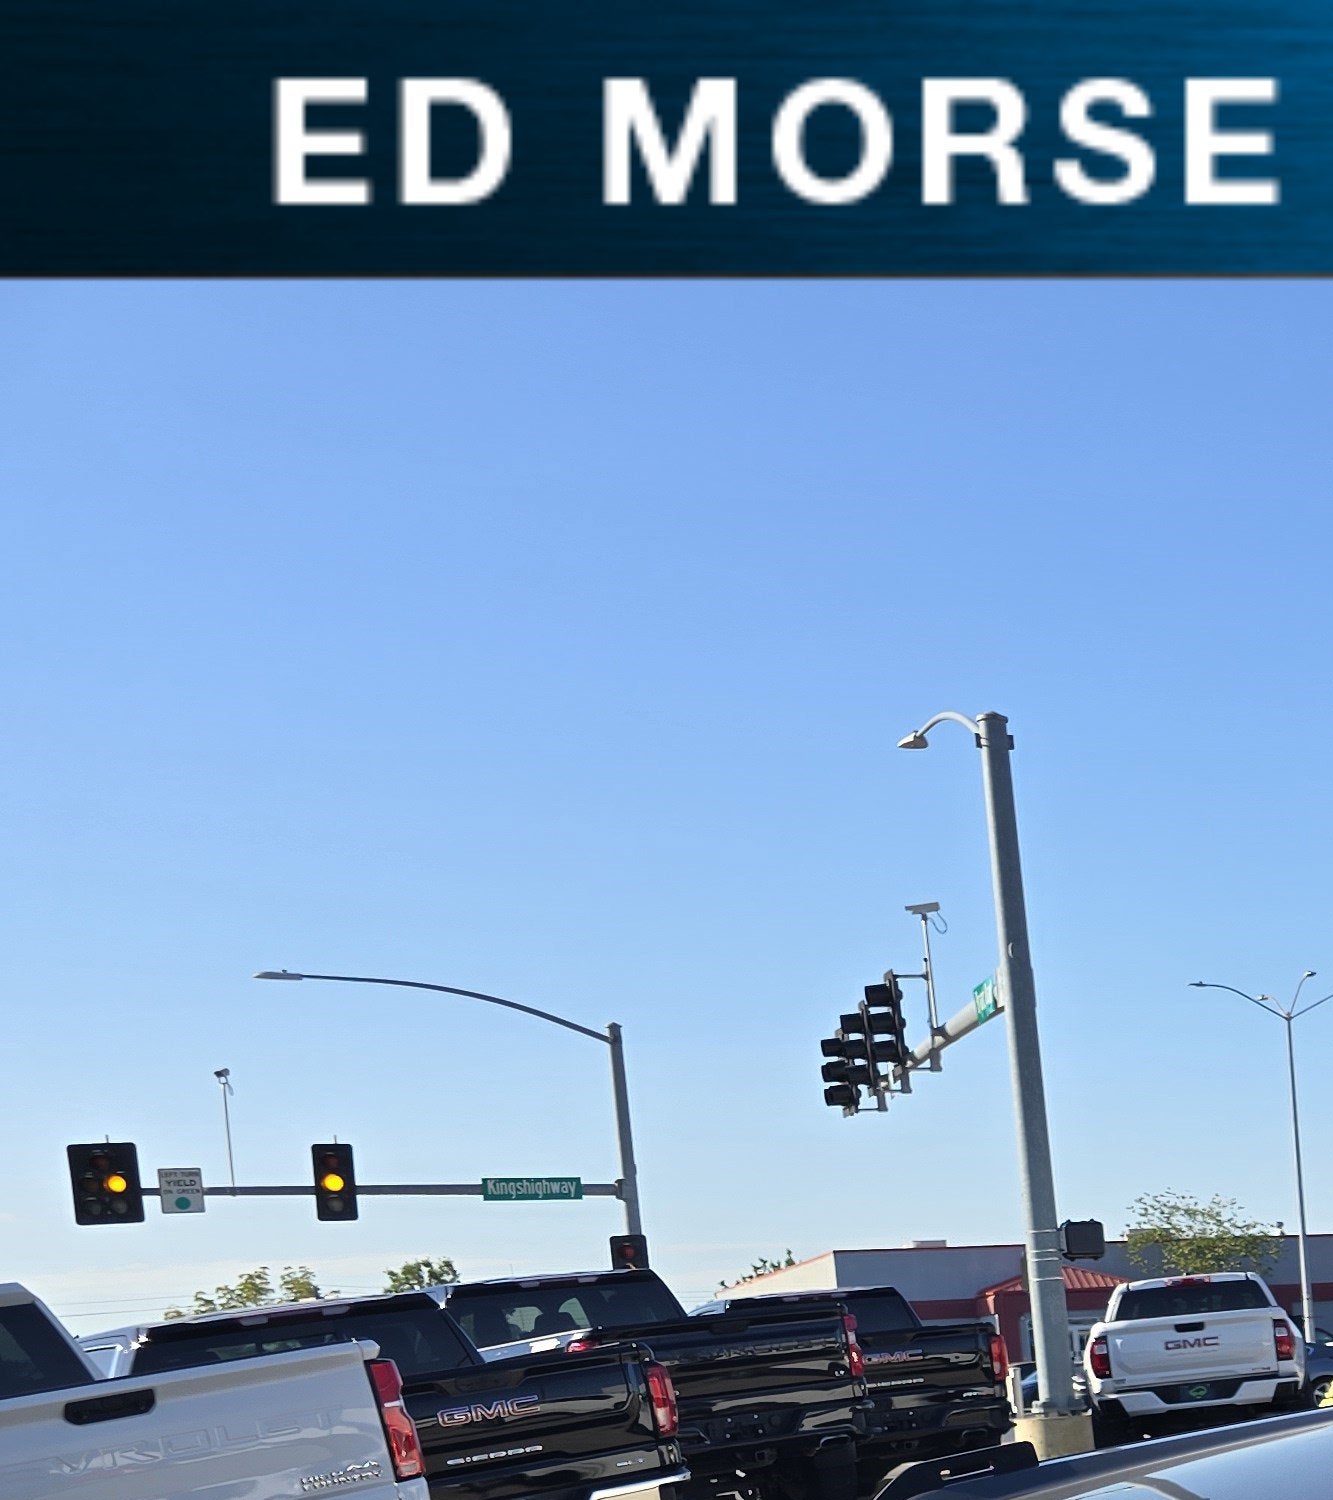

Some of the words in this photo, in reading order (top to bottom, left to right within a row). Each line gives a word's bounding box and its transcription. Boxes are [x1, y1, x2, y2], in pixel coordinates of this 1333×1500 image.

[165, 1179, 197, 1187] YIELD
[487, 1179, 577, 1199] Kingshighway
[1164, 1336, 1219, 1350] GMC
[437, 1394, 541, 1427] GMC
